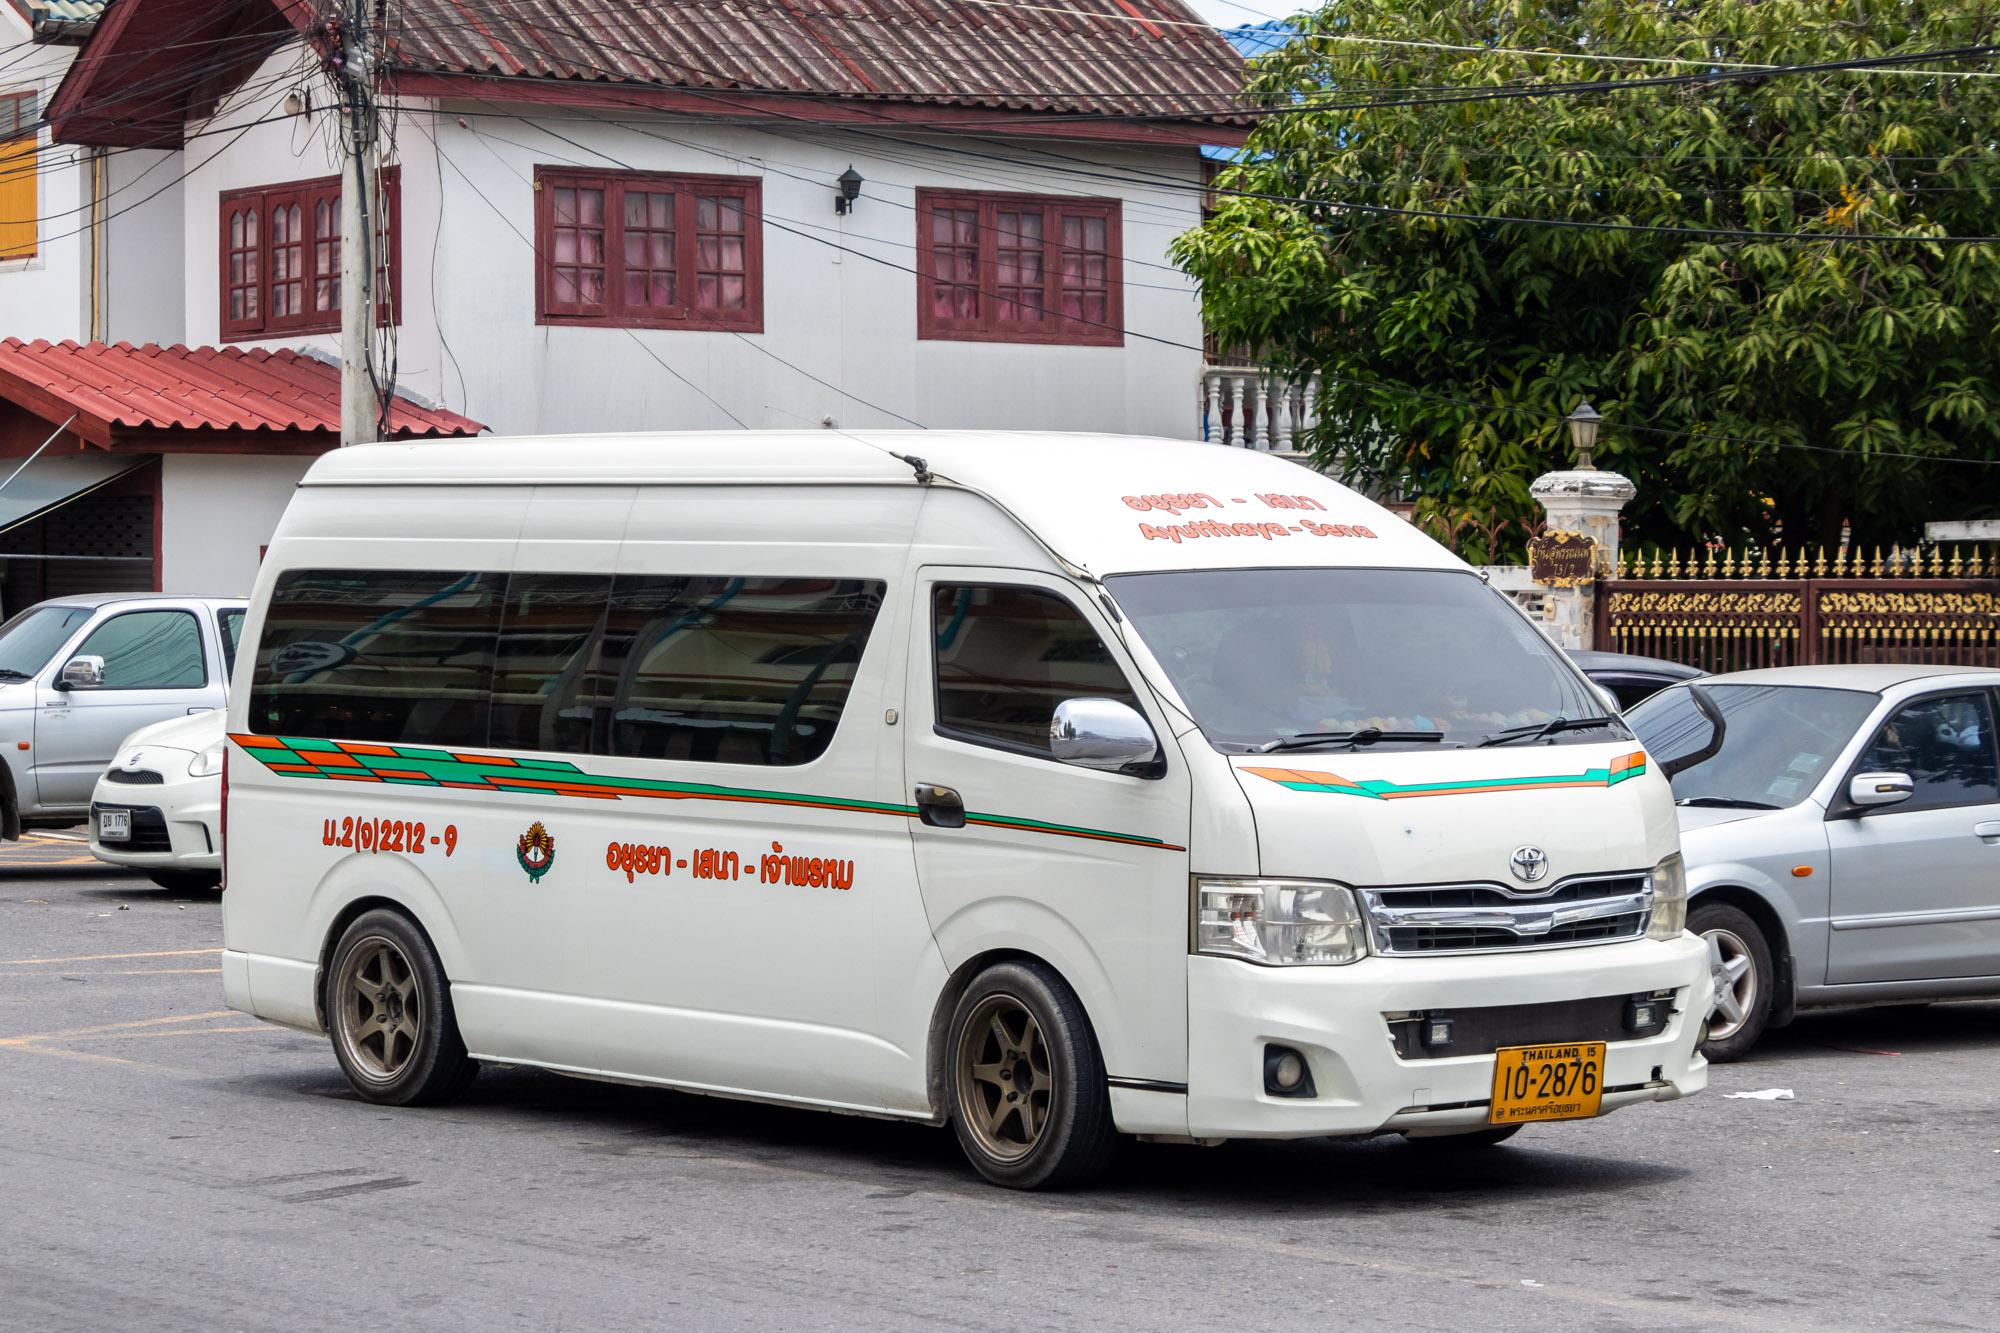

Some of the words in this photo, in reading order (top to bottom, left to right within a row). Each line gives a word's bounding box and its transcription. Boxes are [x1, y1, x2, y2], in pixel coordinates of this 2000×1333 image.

[1254, 493, 1327, 511] เสนา
[1553, 563, 1575, 577] 73/2
[692, 848, 739, 881] เสนา
[760, 841, 854, 890] เจ้าพรหม
[1522, 1047, 1579, 1061] THAILAND
[1587, 1047, 1596, 1057] 15
[1503, 1060, 1597, 1101] 10-2876
[1509, 1101, 1581, 1118] พระนครศรีอยุธยา
